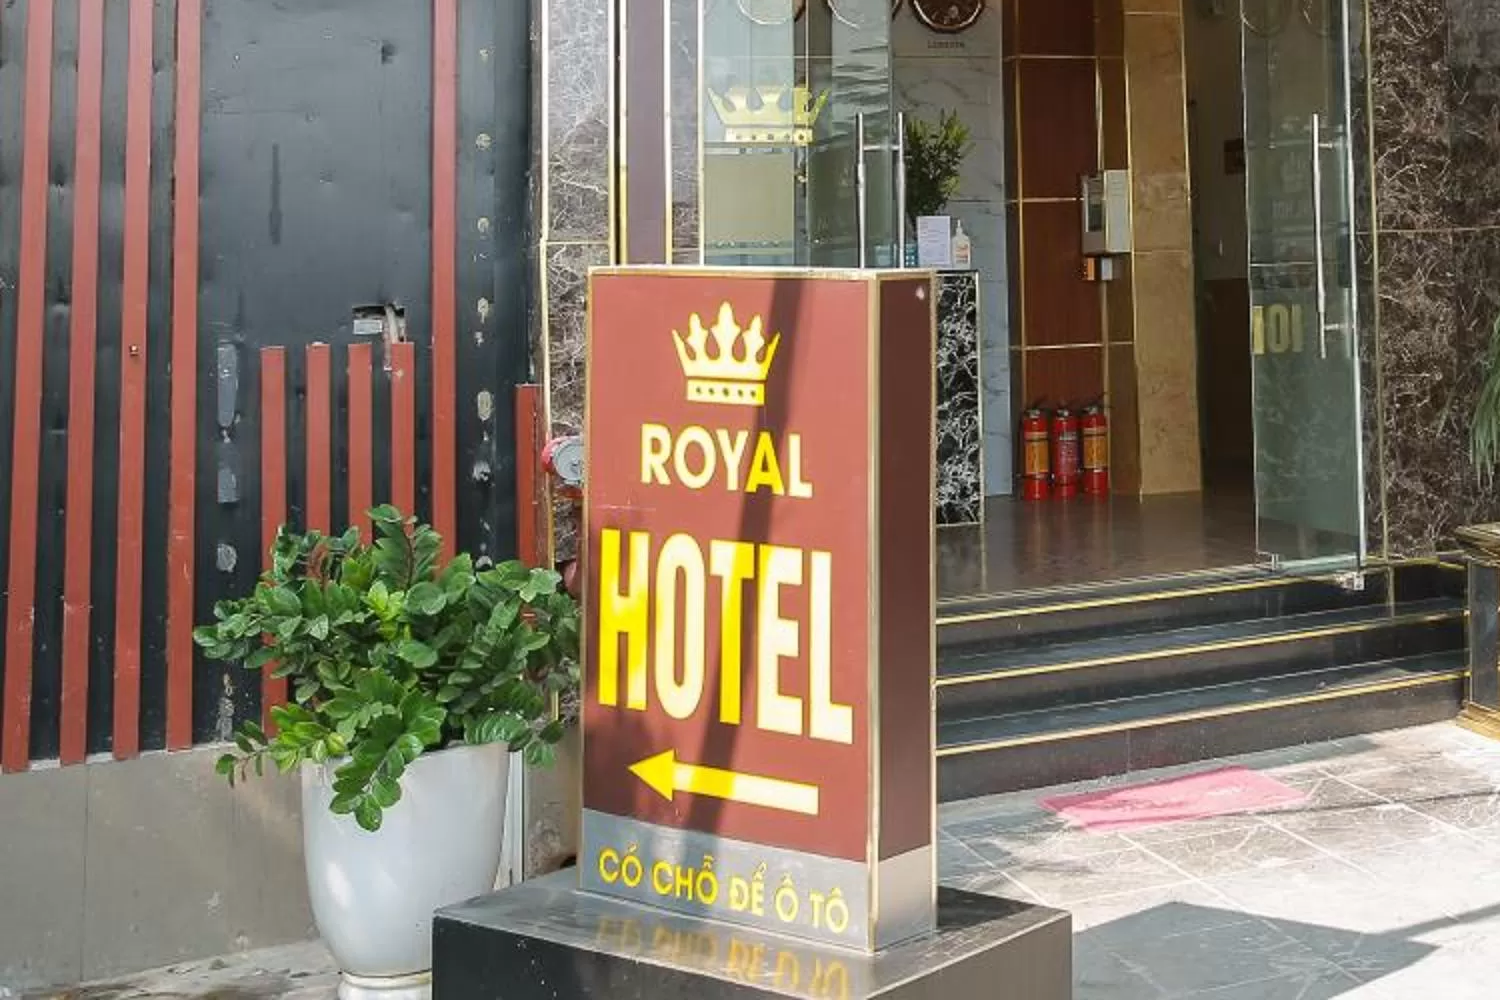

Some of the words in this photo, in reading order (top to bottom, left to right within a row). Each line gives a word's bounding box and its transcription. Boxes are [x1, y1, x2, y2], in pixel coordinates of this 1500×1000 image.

[641, 422, 813, 498] ROYAL
[598, 527, 855, 746] HOTEL
[598, 840, 643, 889] CÓ
[652, 855, 720, 906] CHỖ
[729, 860, 768, 917] ĐỂ
[775, 872, 800, 923] Ô
[809, 886, 850, 934] TÔ
